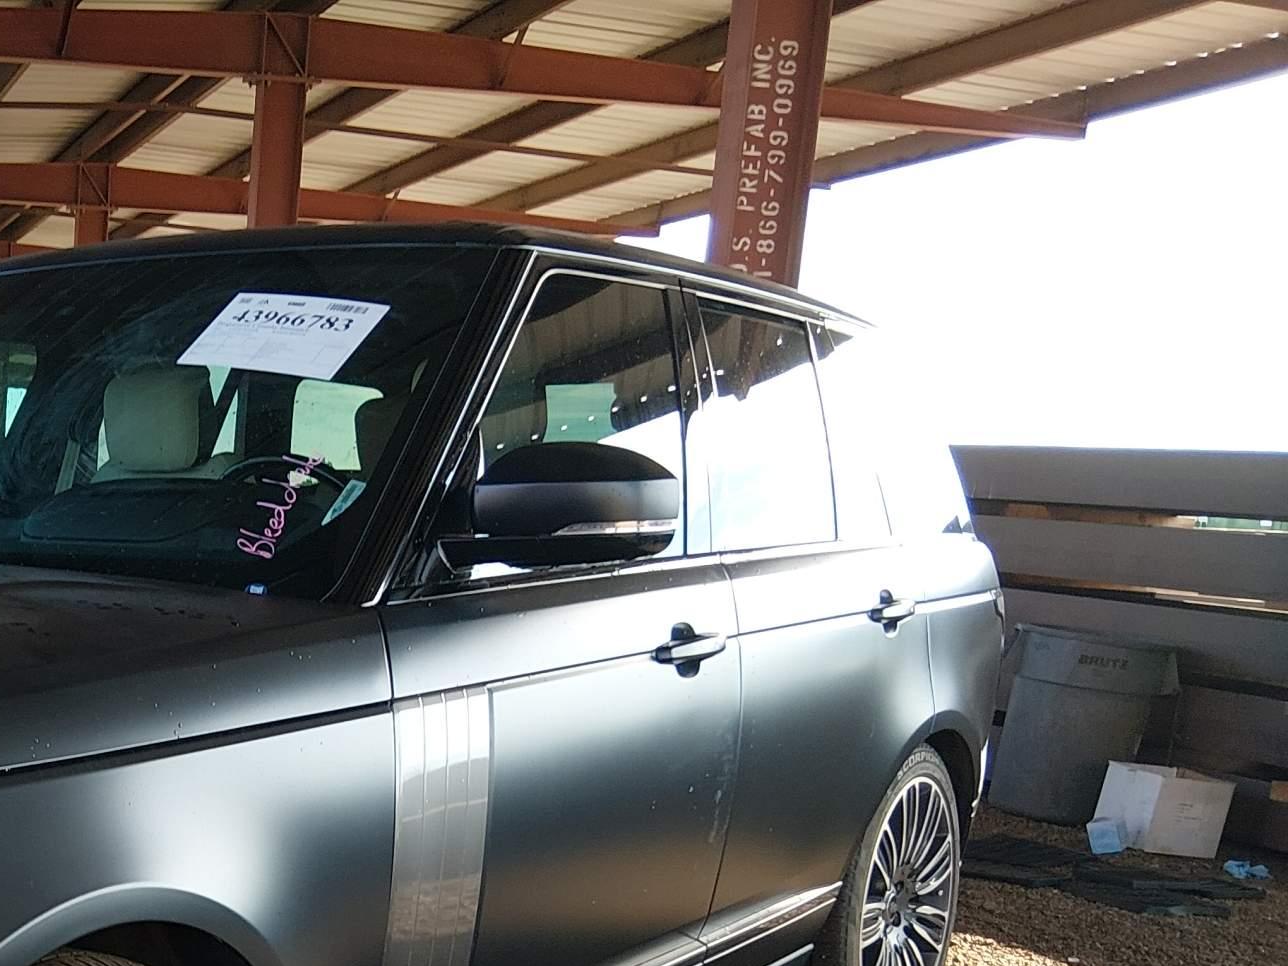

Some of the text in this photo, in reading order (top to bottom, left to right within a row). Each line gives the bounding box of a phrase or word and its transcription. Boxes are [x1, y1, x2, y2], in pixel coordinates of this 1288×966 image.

[750, 36, 776, 88] INC.
[736, 103, 766, 211] PREFAB
[753, 39, 799, 277] 1-866-799-0969
[232, 308, 354, 332] 43966783
